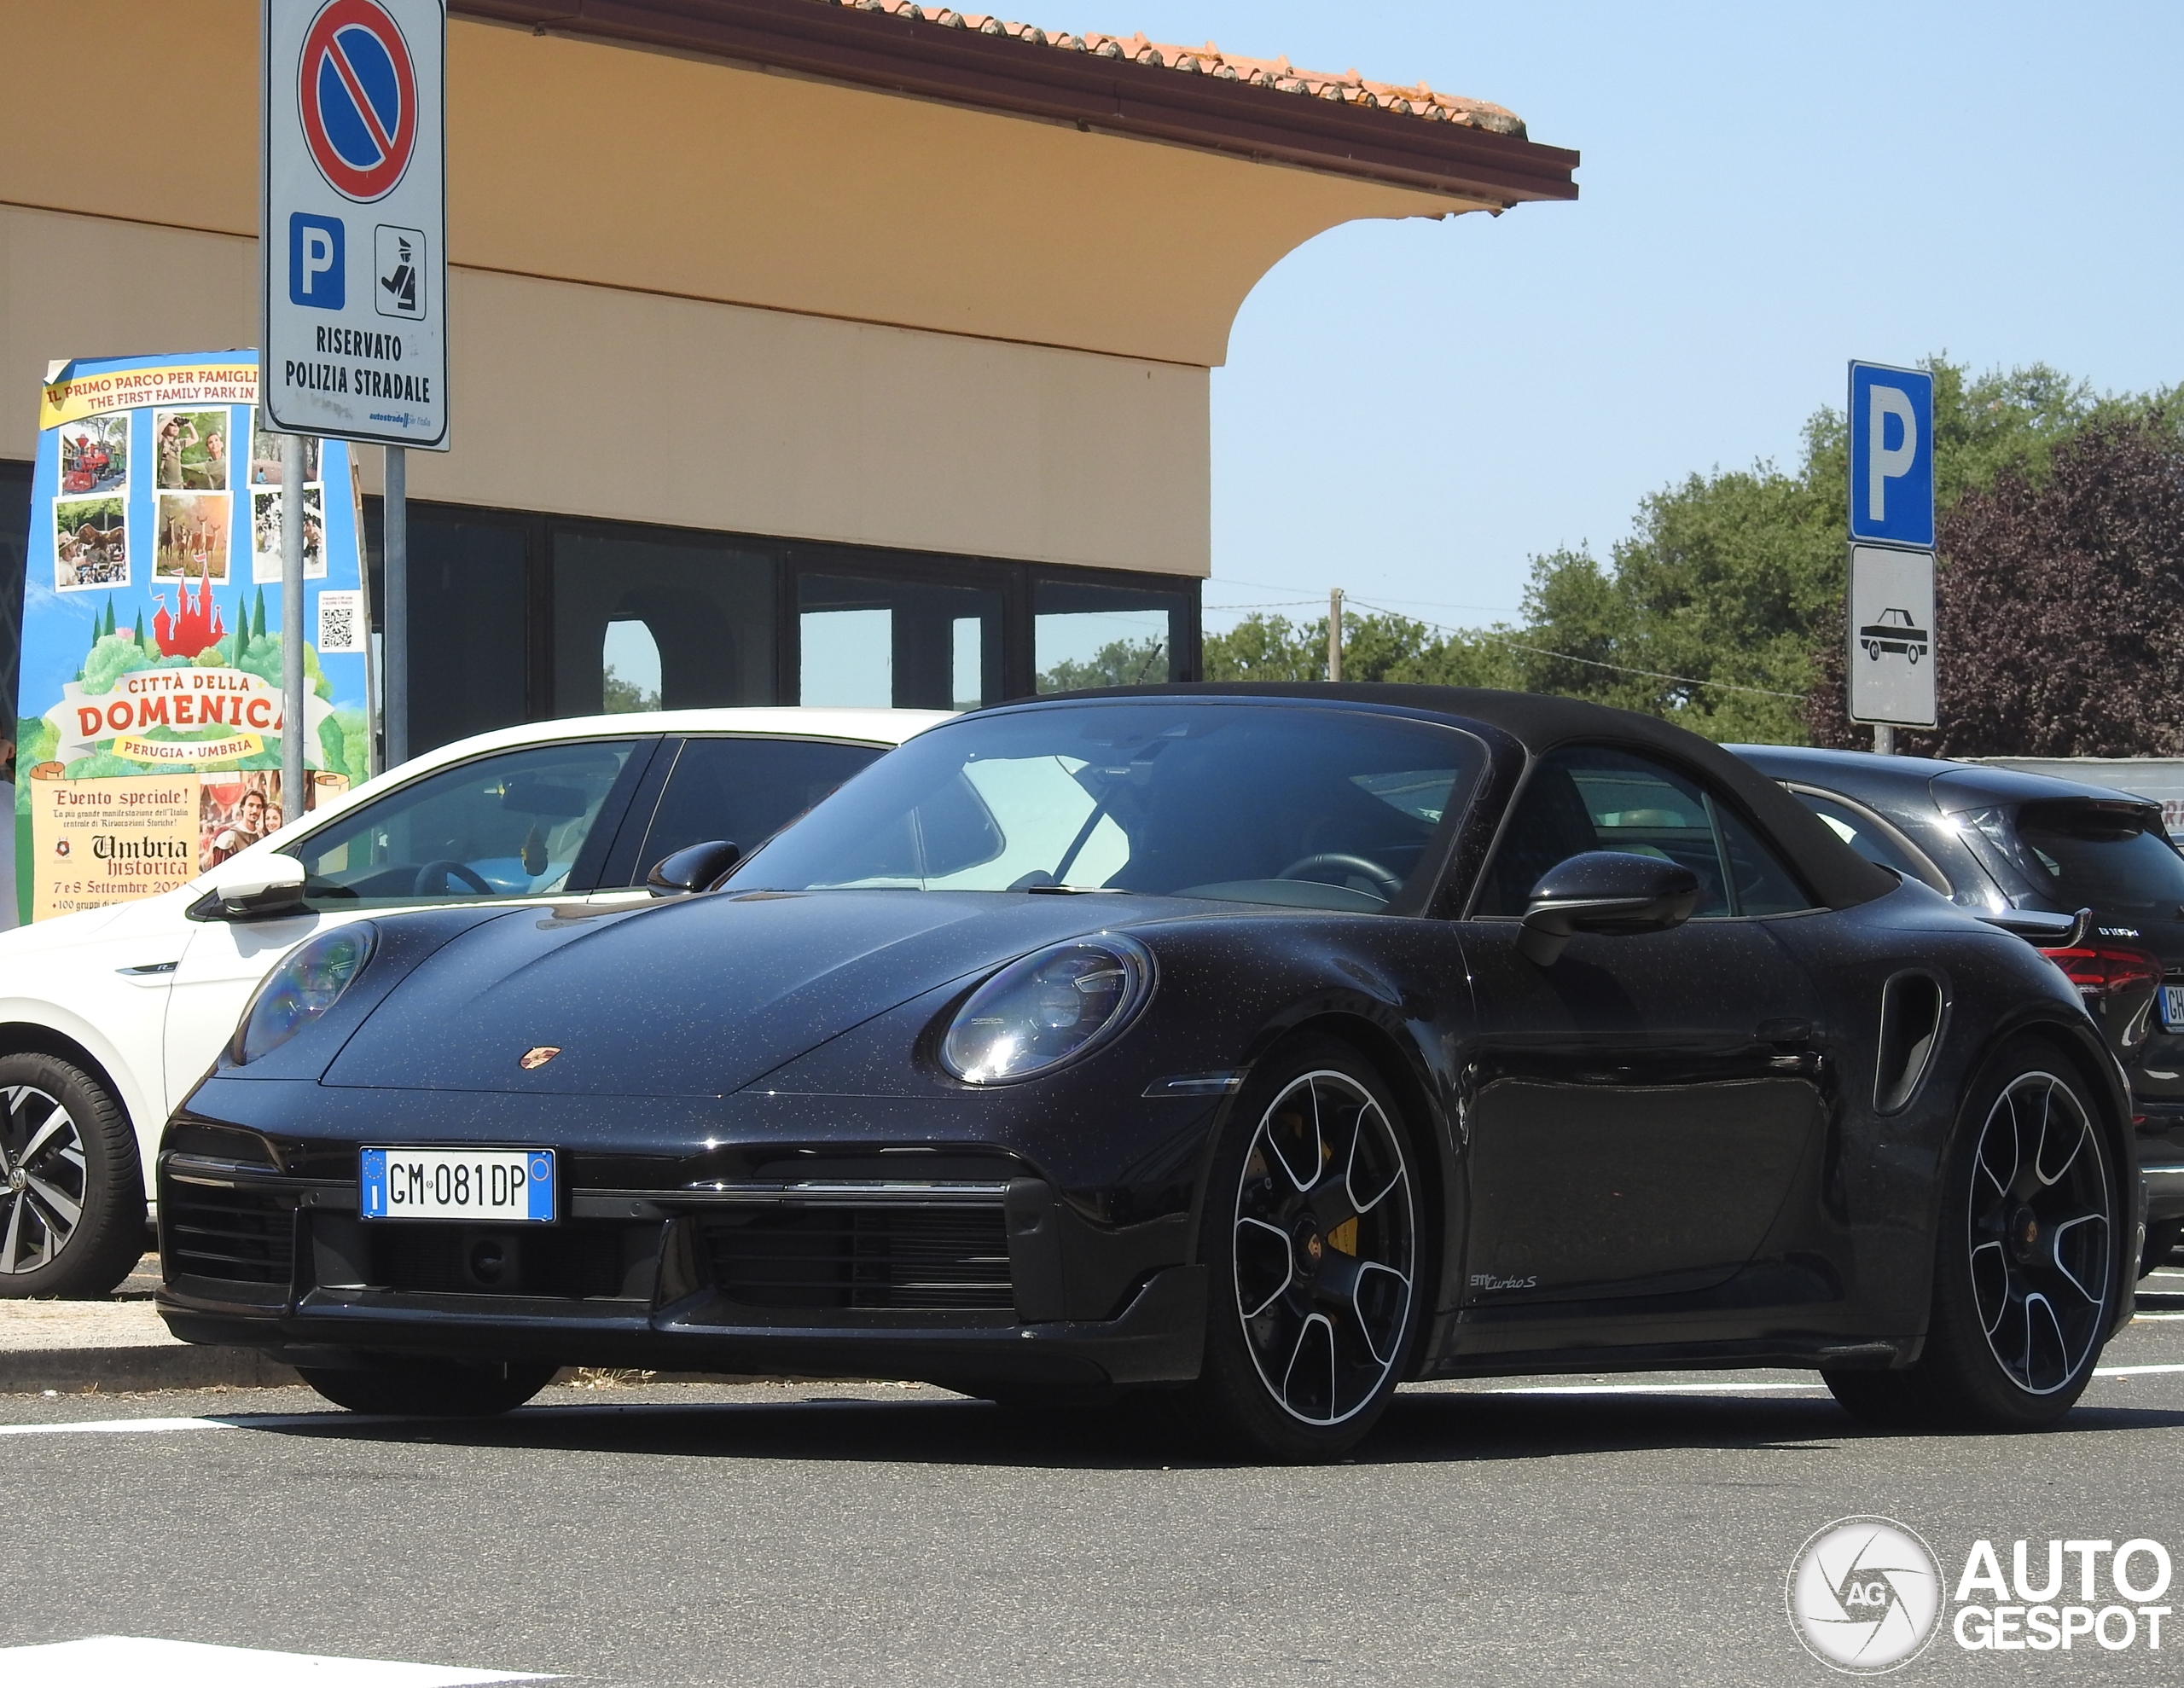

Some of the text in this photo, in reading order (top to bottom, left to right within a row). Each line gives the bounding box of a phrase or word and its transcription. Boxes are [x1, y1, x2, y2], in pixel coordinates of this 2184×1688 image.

[302, 226, 334, 294] P
[317, 326, 402, 362] RISERVATO
[47, 391, 62, 403] IL
[65, 379, 111, 398] PRIMO
[114, 373, 164, 390] PARCO
[168, 372, 195, 385] PER
[286, 361, 430, 403] POLIZIA STRADALE
[88, 386, 254, 409] THE FIRST FAMILY PARK IN
[1868, 384, 1917, 522] P
[128, 672, 250, 693] CITTÀ DELLA
[125, 740, 253, 758] PERUGIA UMBRIA
[52, 788, 189, 807] Evento speciale!
[78, 810, 100, 819] grande
[102, 809, 153, 817] manifestazione
[100, 819, 145, 827] Rievocazioni
[91, 835, 188, 860] Umbria
[107, 858, 188, 879] historica
[54, 880, 187, 894] 7 e 8 Settembre 202
[59, 900, 74, 909] 100
[76, 899, 101, 911] gruppi
